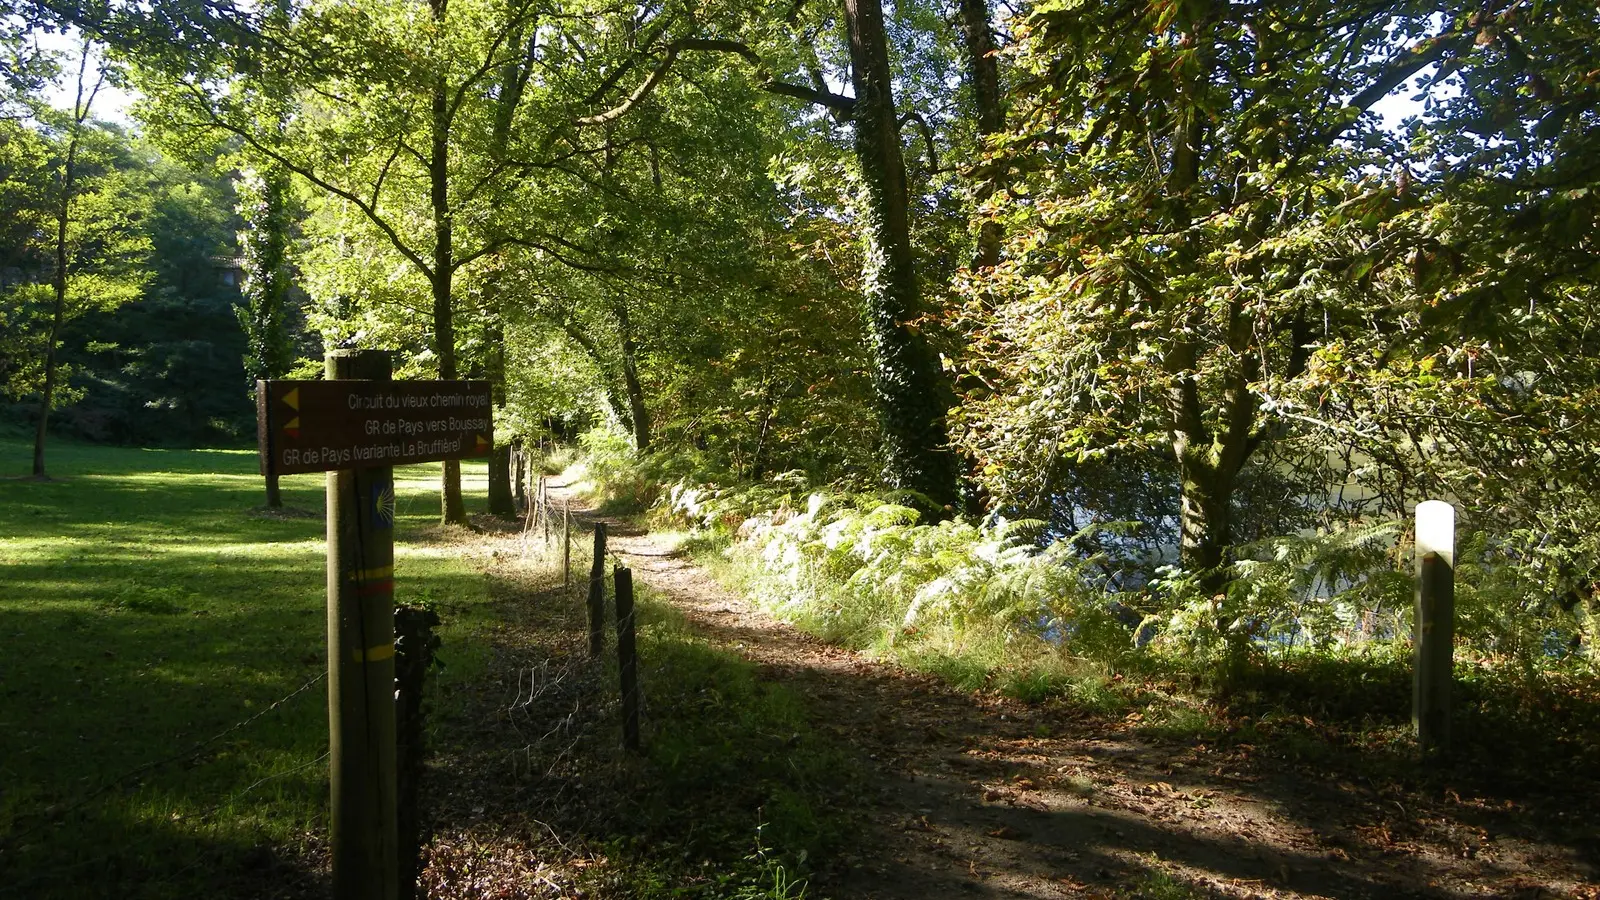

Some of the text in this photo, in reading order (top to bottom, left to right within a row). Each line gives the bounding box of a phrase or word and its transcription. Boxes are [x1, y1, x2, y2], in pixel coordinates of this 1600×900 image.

[348, 392, 489, 410] Circuit du vieux chemin royal
[365, 416, 489, 436] GR de Pays vers Boussay
[283, 438, 461, 466] GR de Pays (variante La Bruffière)
